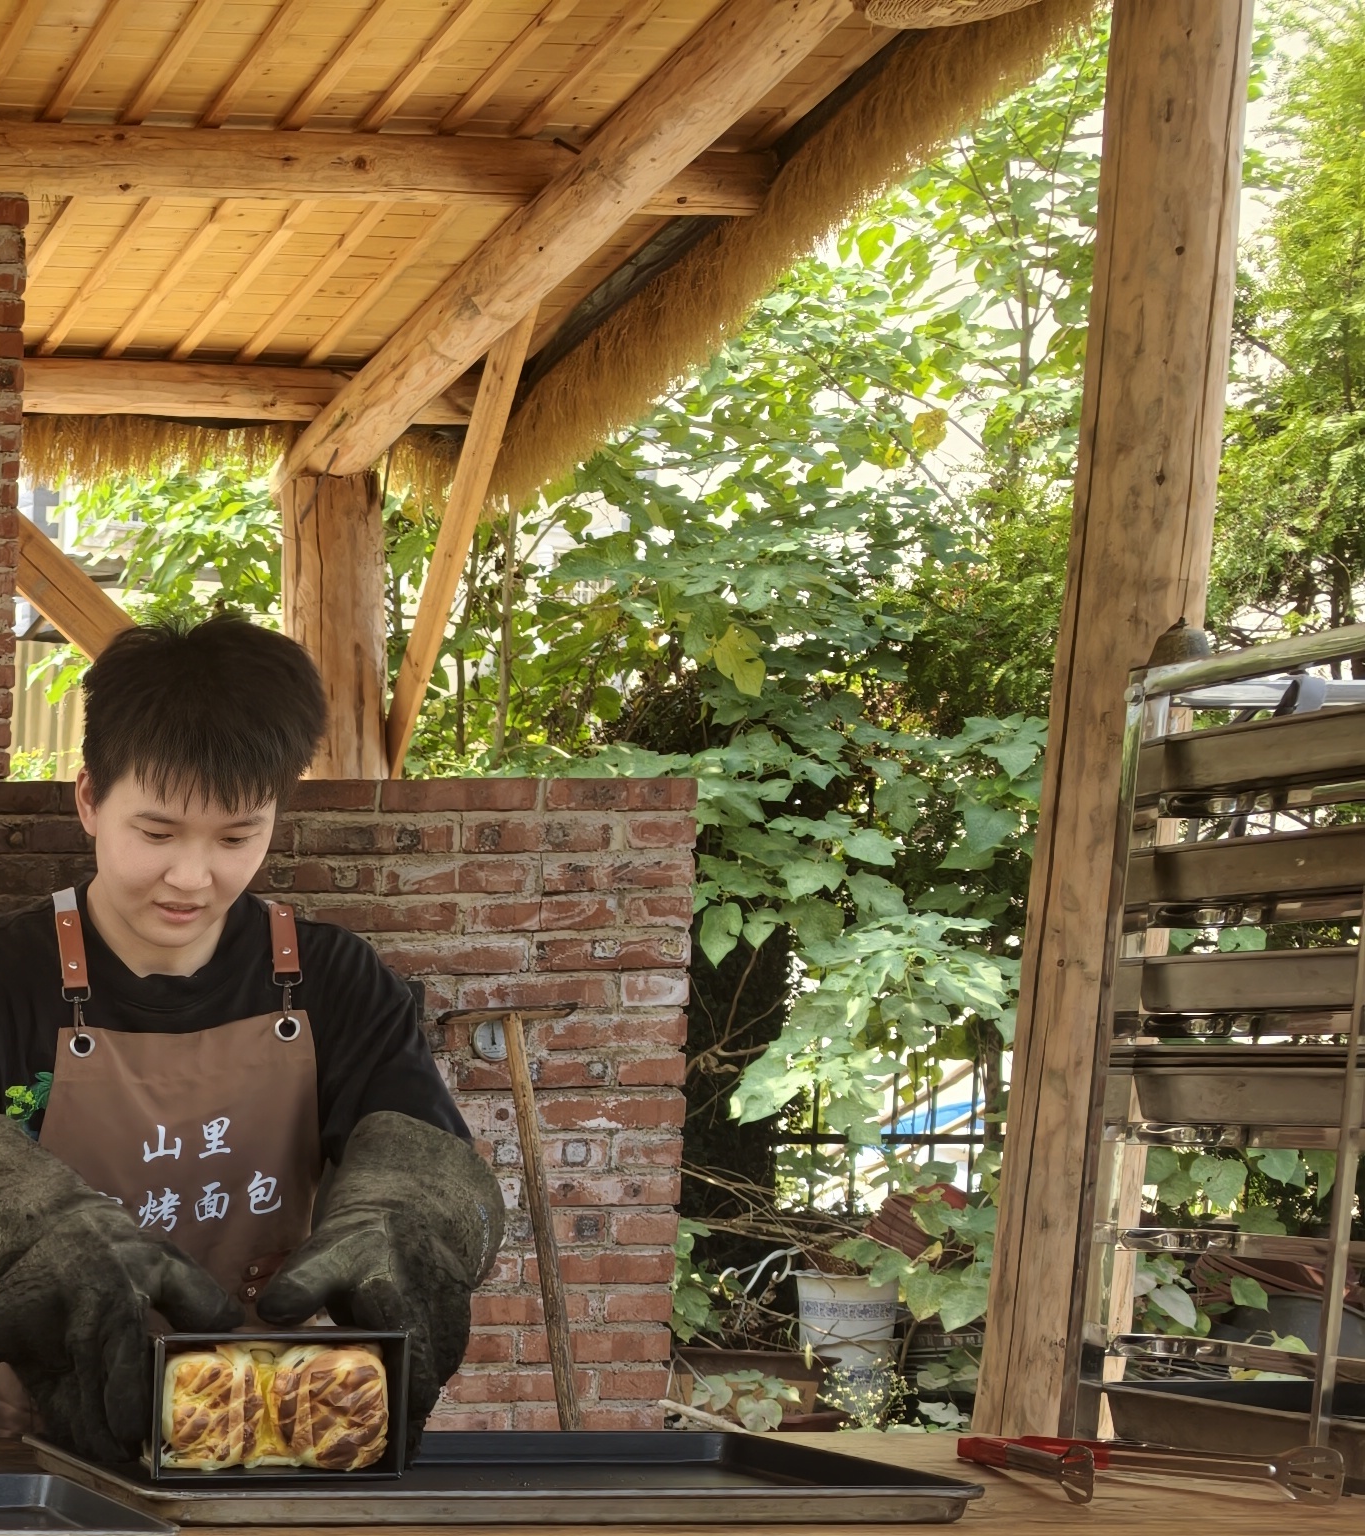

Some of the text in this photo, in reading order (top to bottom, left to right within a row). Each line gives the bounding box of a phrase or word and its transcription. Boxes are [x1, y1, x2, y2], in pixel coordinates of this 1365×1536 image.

[142, 1116, 231, 1163] 山里
[98, 1170, 282, 1232] 烤面包
